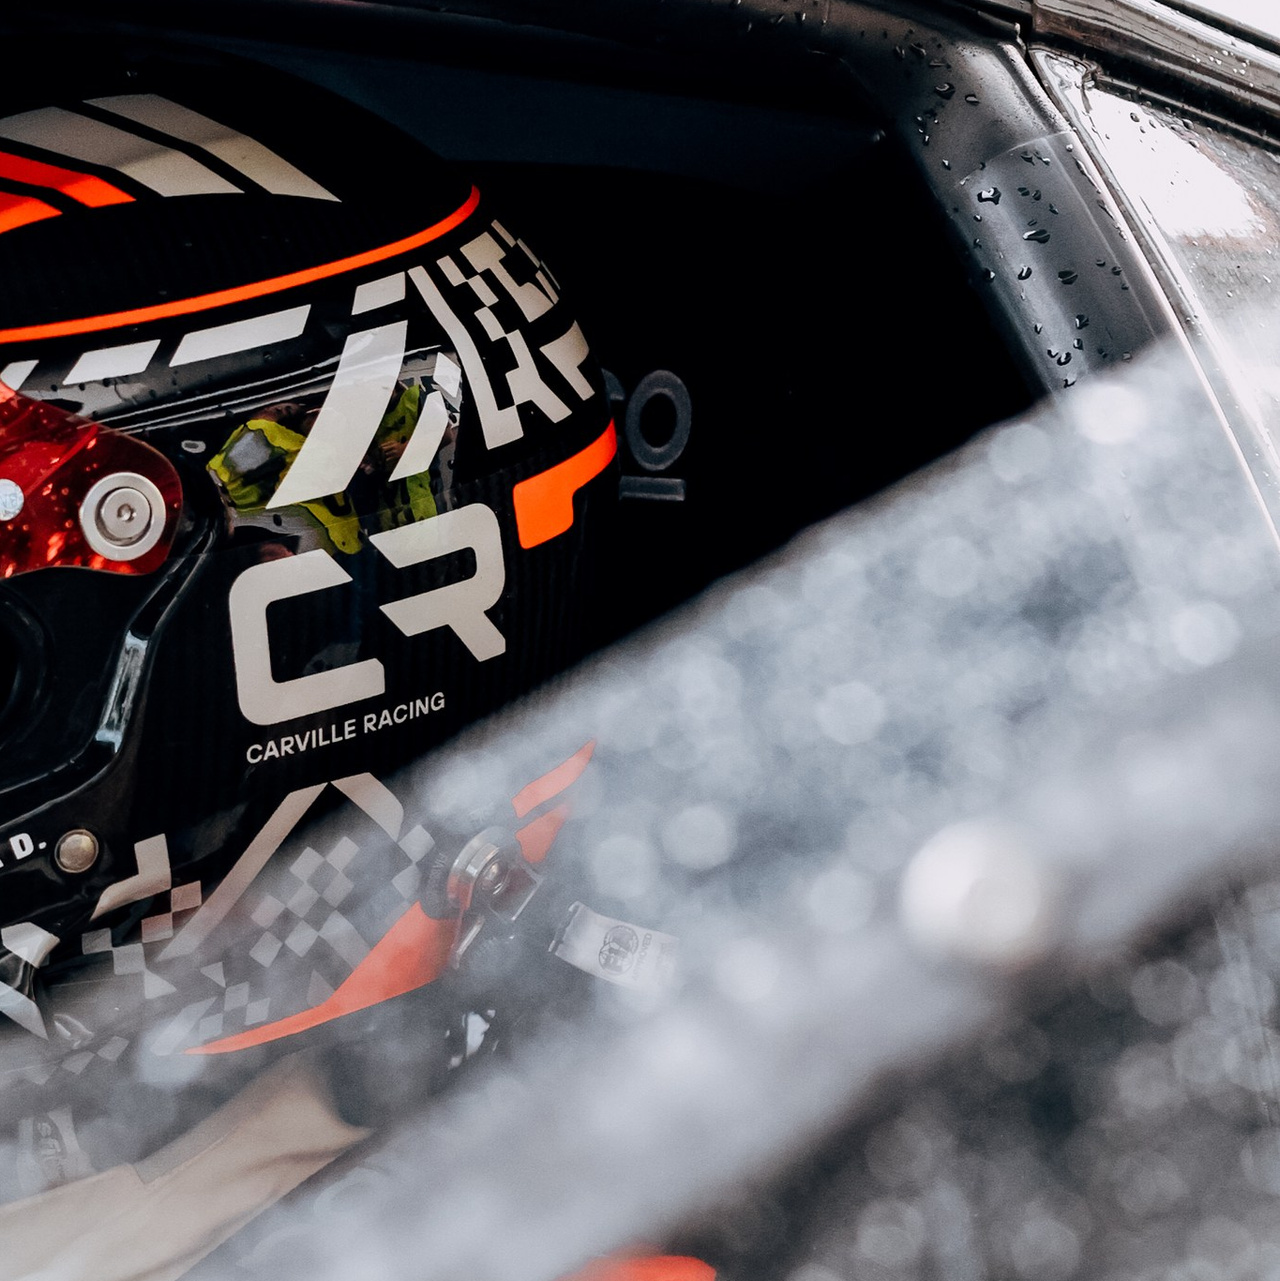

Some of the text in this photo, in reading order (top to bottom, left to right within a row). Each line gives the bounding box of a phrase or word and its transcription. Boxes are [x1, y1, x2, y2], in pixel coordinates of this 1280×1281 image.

[229, 503, 506, 726] CR
[246, 692, 445, 764] CARVILLE RACING
[9, 832, 47, 860] D.
